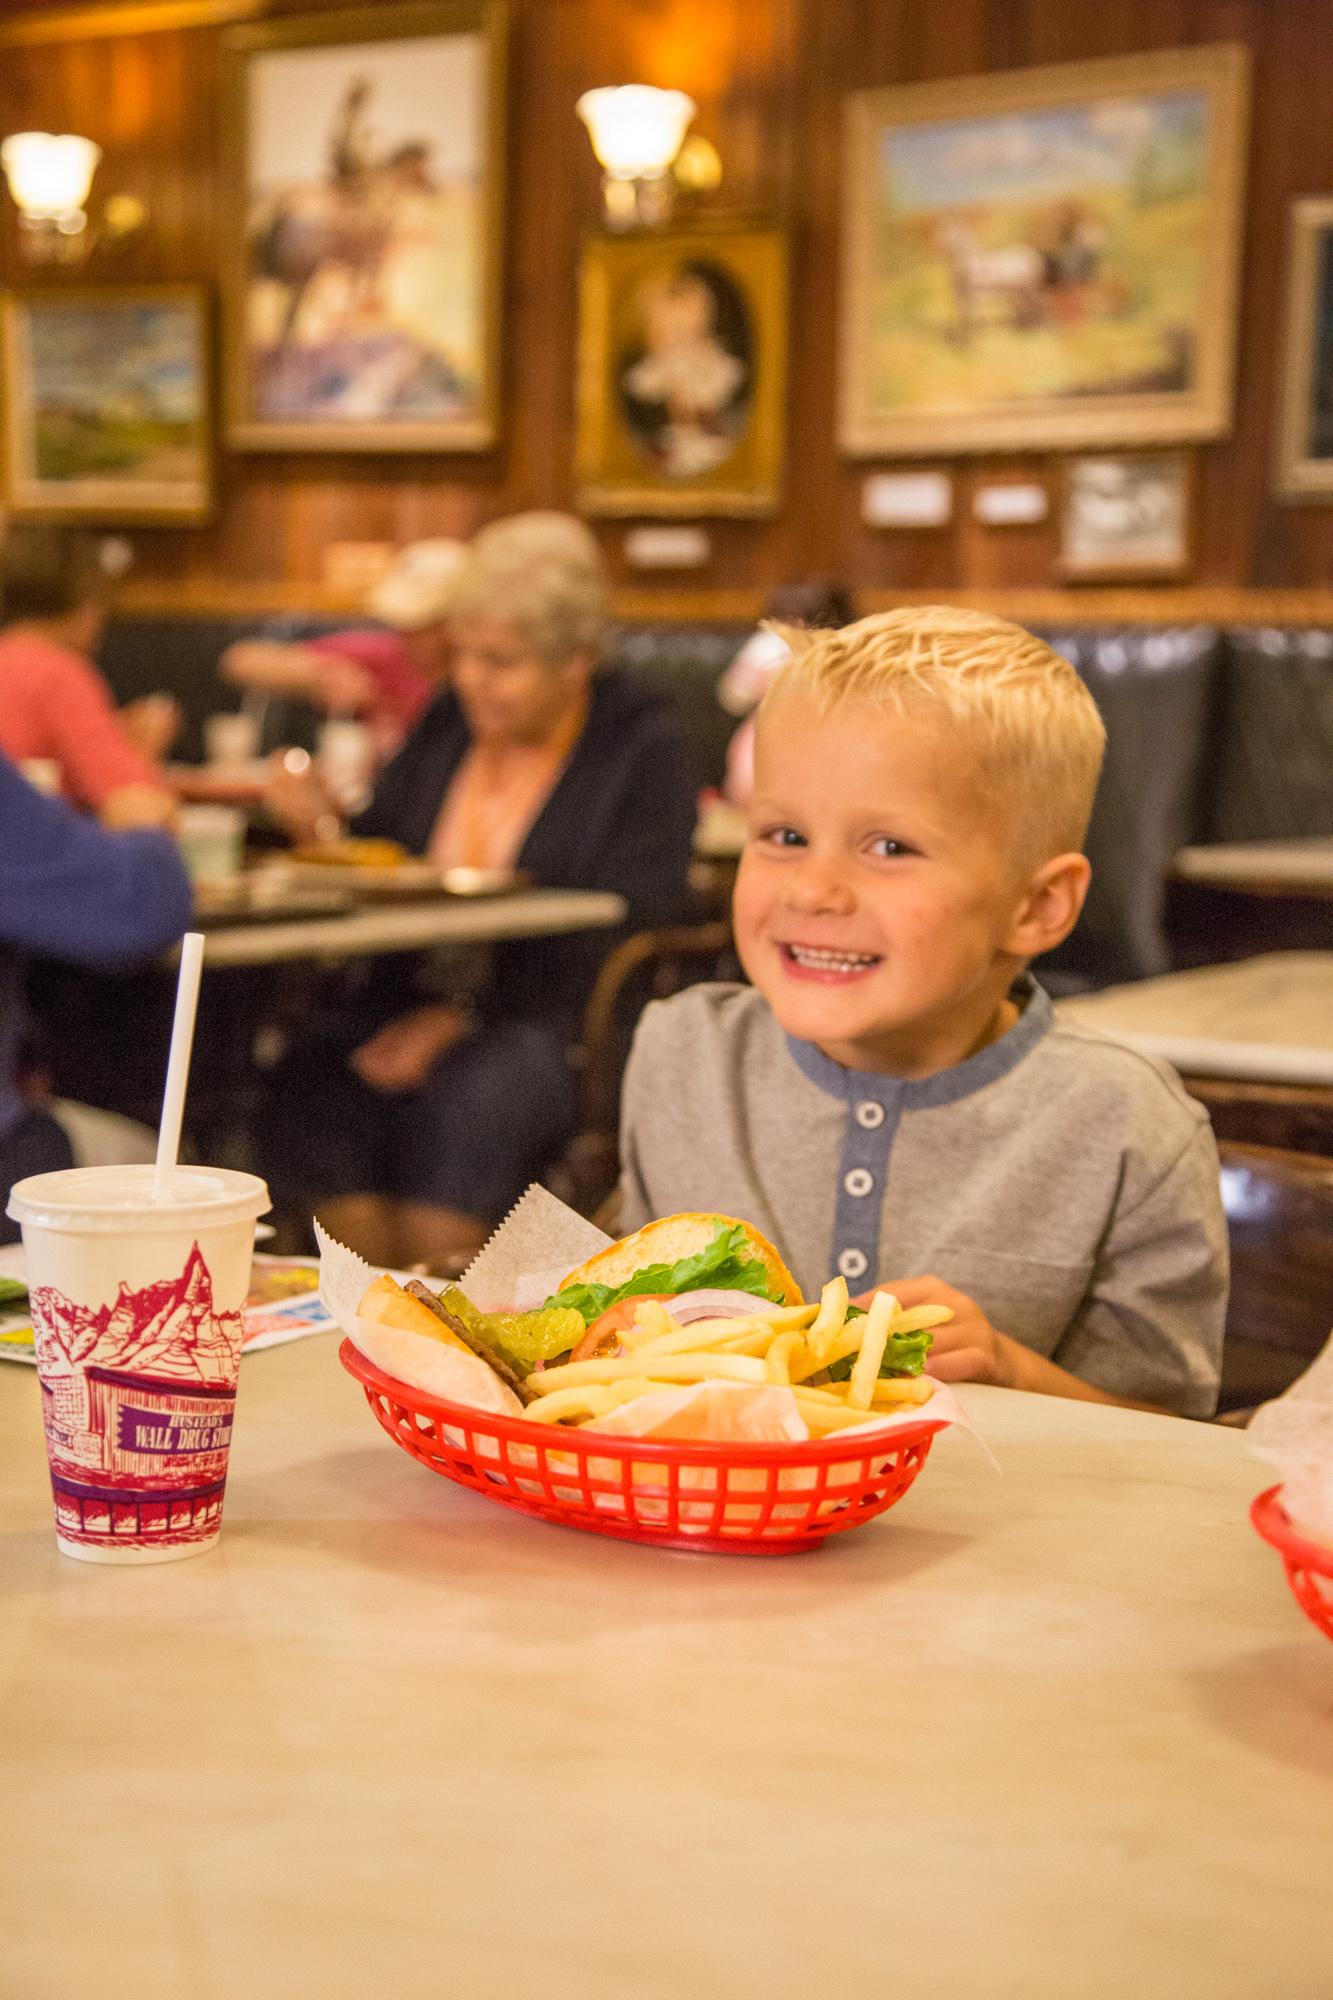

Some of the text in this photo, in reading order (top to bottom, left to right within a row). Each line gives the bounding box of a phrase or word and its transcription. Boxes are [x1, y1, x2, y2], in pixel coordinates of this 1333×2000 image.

[169, 1415, 223, 1428] HUSTEAD'S
[136, 1425, 172, 1449] WALL
[177, 1427, 210, 1449] DRUG
